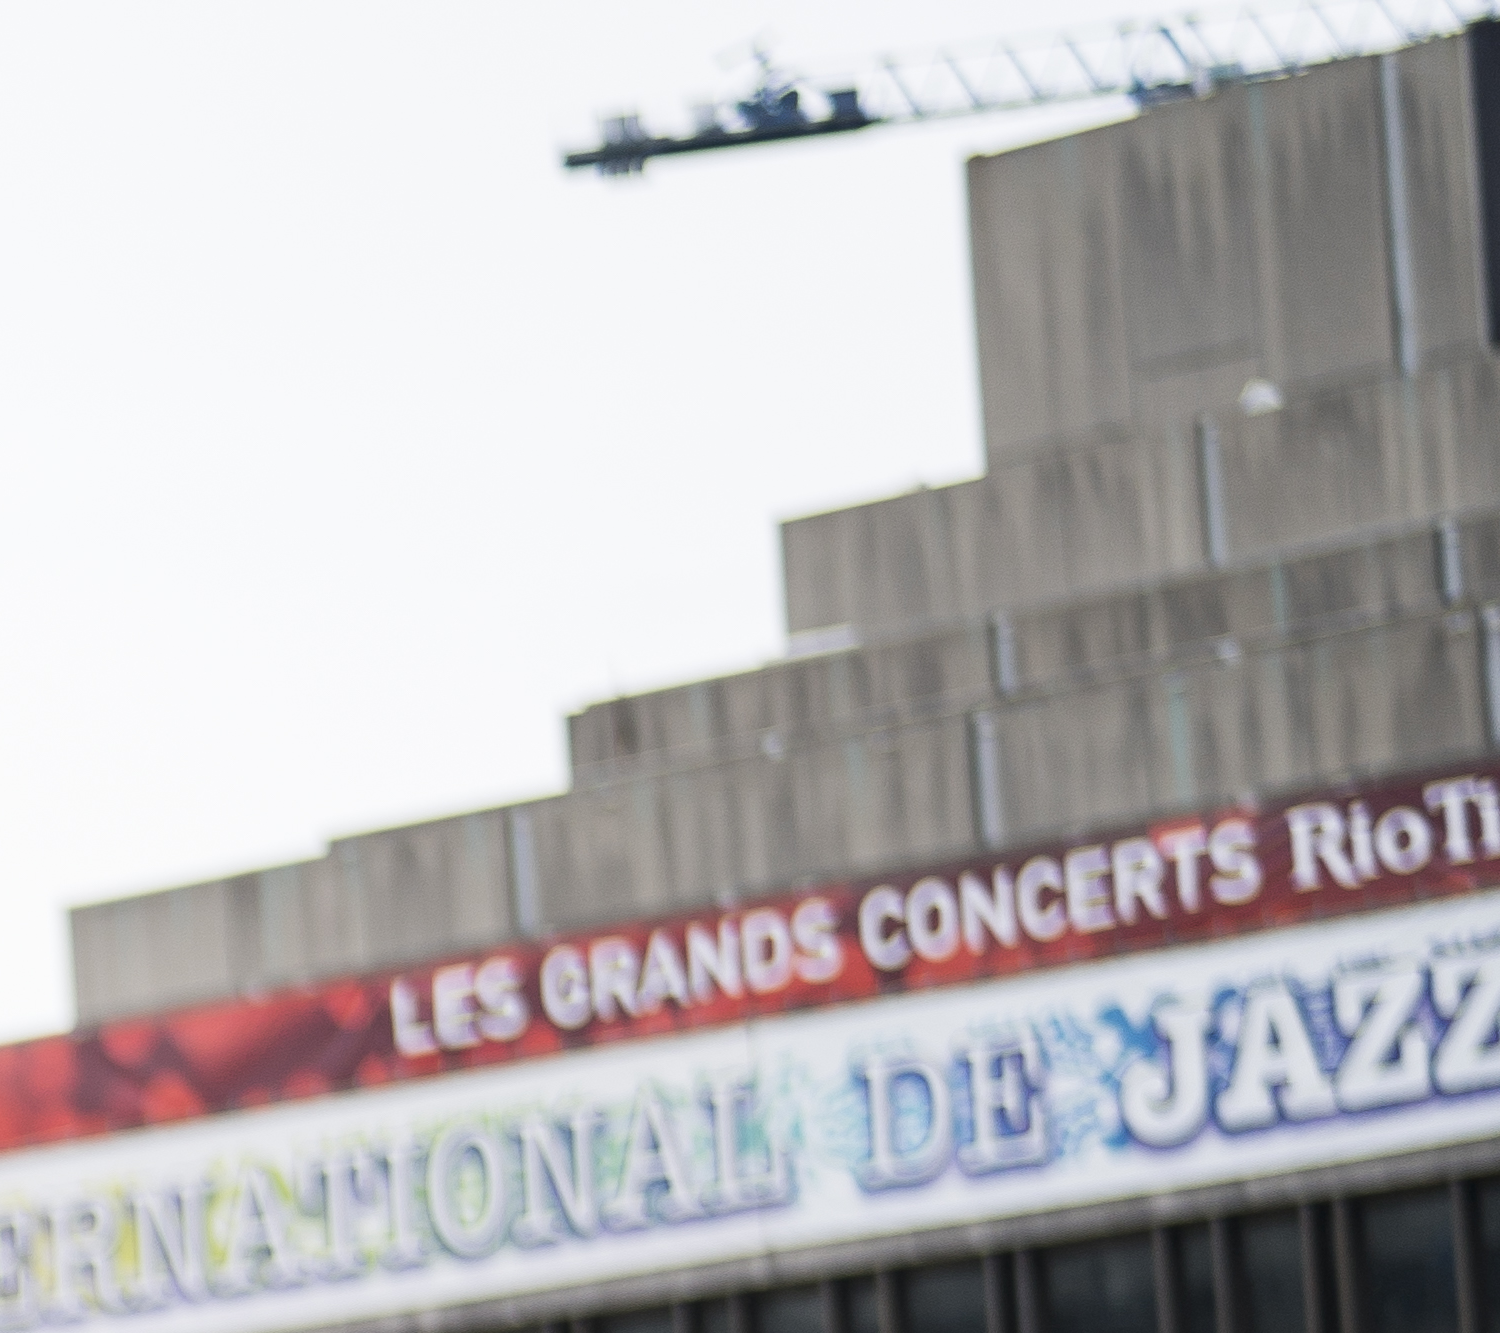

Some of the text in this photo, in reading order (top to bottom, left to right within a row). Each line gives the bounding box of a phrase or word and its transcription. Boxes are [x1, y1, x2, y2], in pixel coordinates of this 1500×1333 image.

[388, 952, 530, 1056] LES
[539, 897, 844, 1031] GRANDS
[858, 817, 1264, 971] CONCERTS
[858, 1030, 1053, 1188] DE
[1120, 960, 1500, 1148] JAZZ
